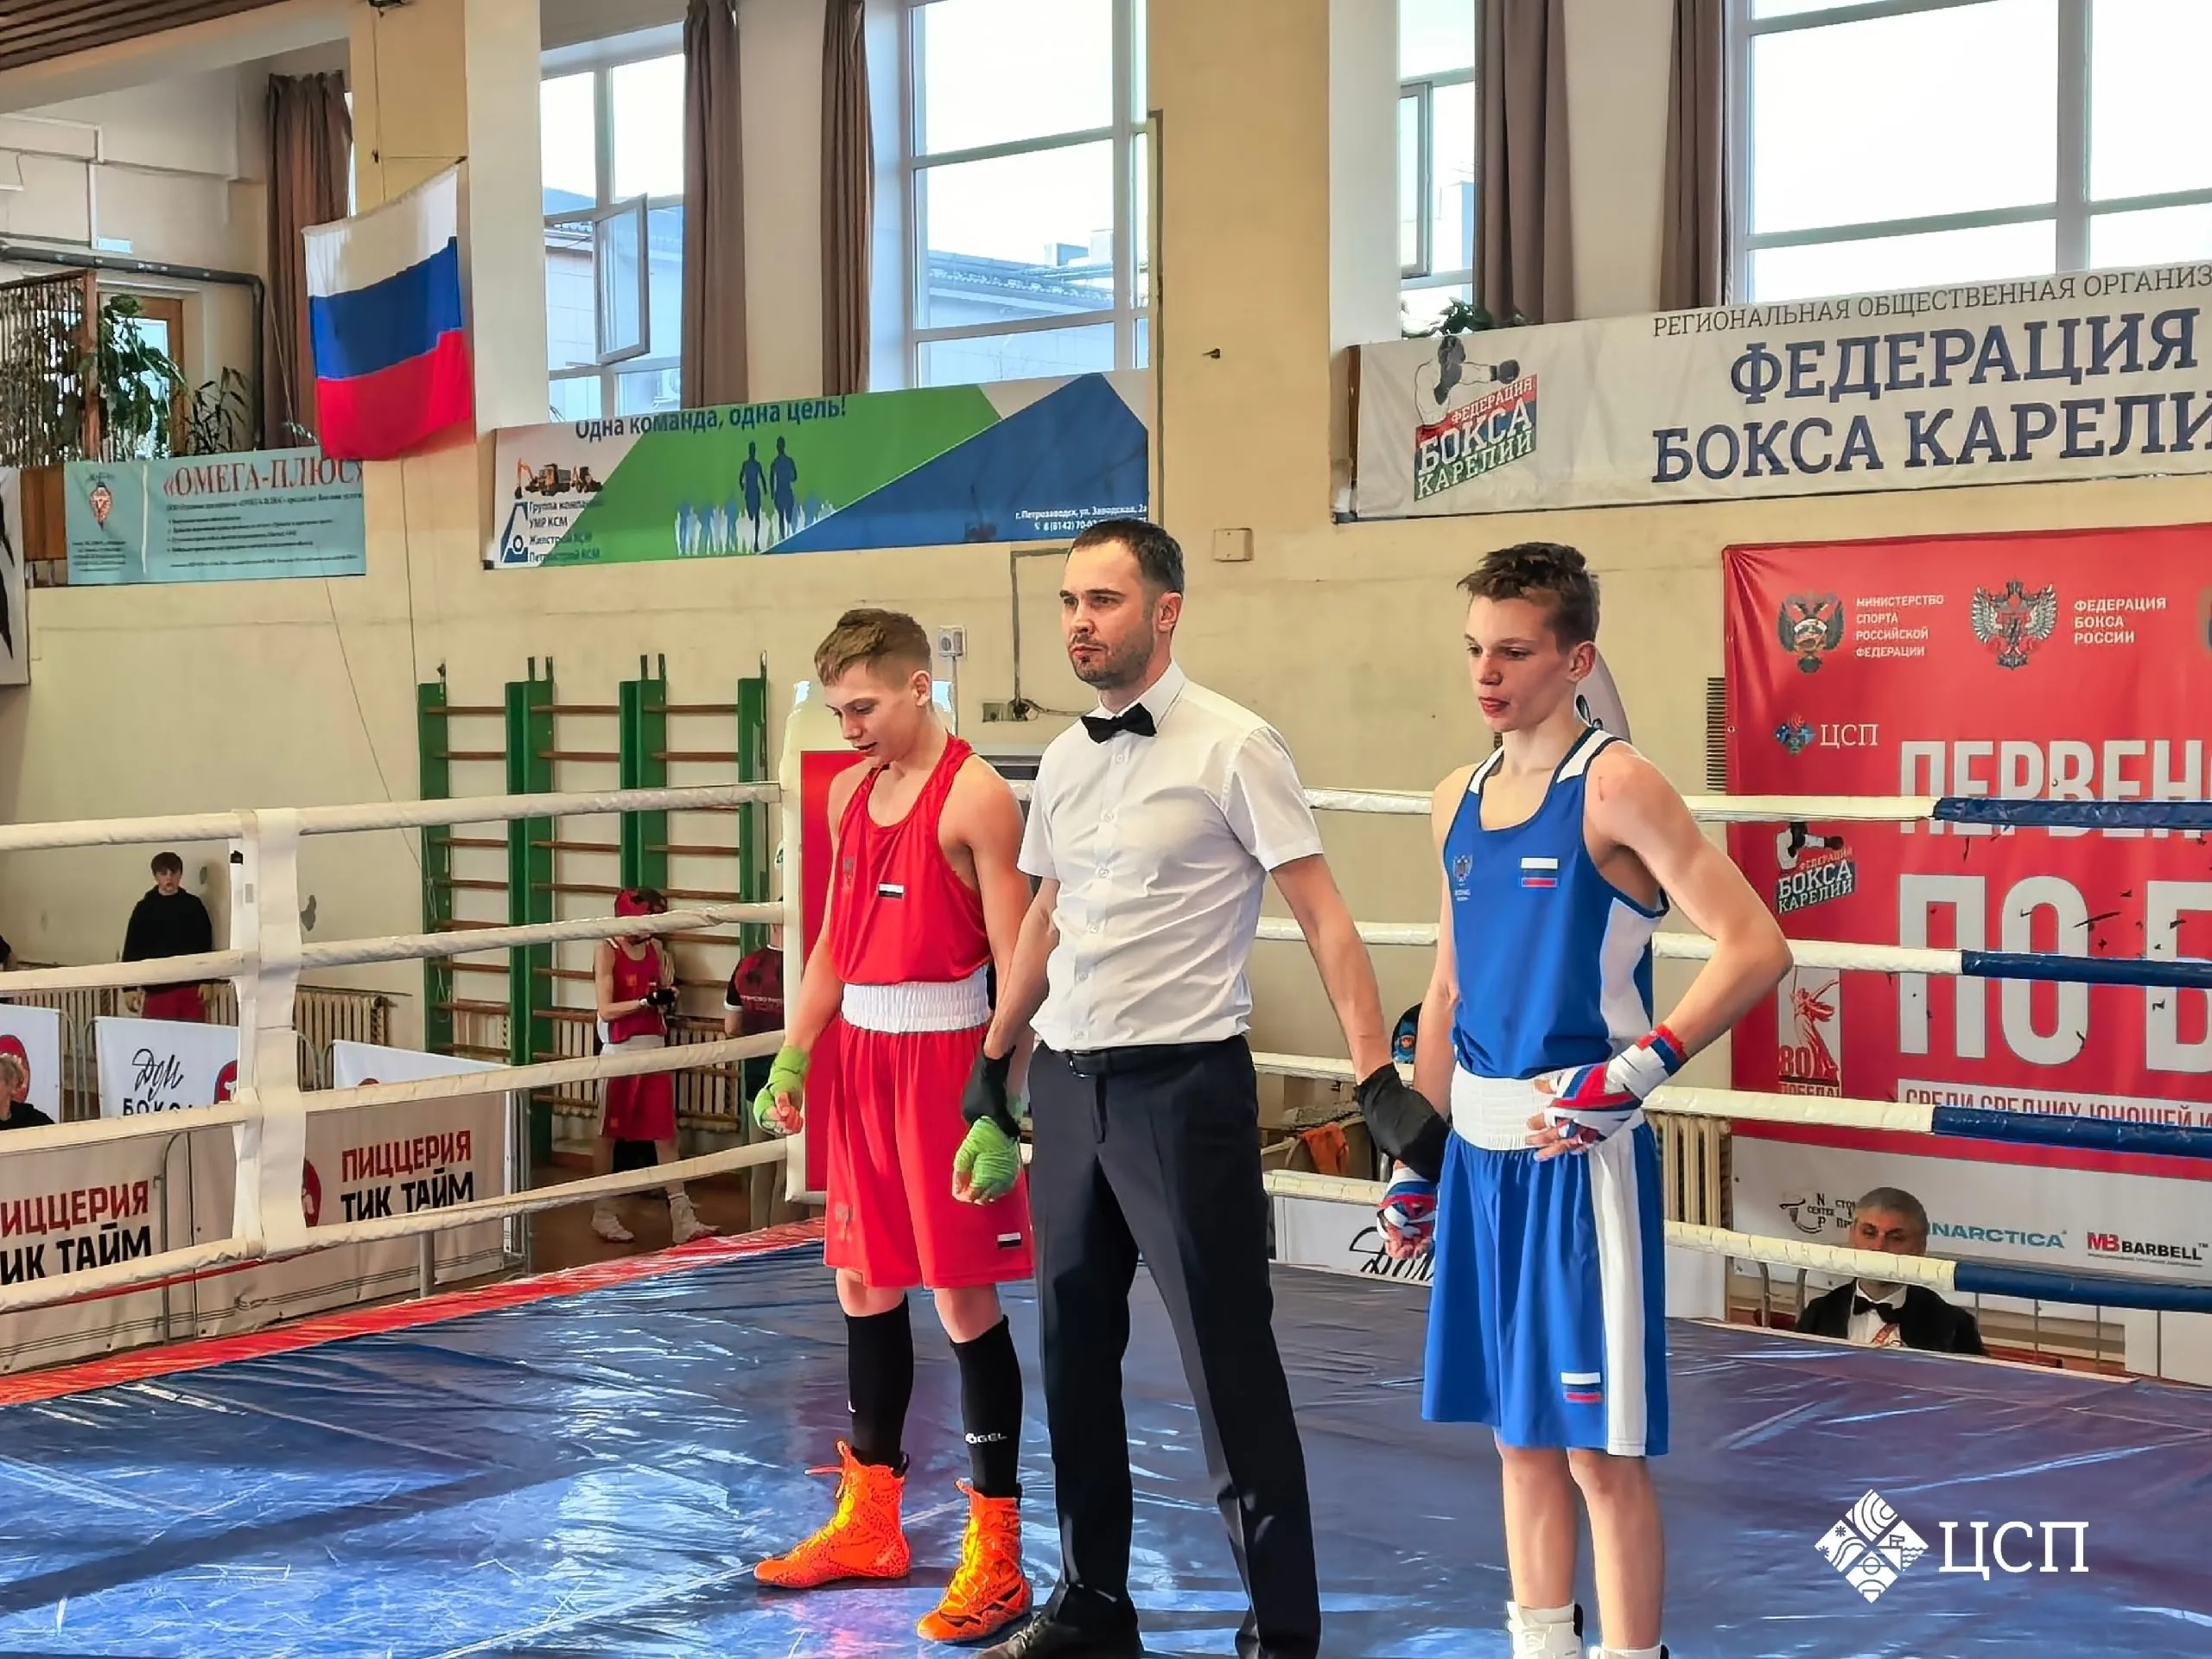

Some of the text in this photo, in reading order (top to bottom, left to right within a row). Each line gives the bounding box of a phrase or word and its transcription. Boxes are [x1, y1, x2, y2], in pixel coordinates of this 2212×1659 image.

[1653, 264, 2212, 337] РЕГИОНАЛЬНАЯ ОБЩЕСТВЕННАЯ ОРГАНИЗ
[1731, 308, 2200, 404] ФЕДЕРАЦИЯ
[575, 396, 846, 442] Одна команда, одна цель!
[1452, 378, 1532, 423] ФЕДЕРАЦИЯ
[1418, 397, 1532, 475] БОКСА
[1651, 391, 2212, 482] БОКСА КАРЕЛИ
[1418, 430, 1532, 499] КАРЕЛИИ
[1856, 594, 1944, 607] МИНИСТЕРСТВО
[1856, 613, 1898, 624] СПОРТА
[2074, 597, 2166, 613] ФЕДЕРАЦИЯ
[1856, 626, 1929, 640] РОССИЙСКОЙ
[2075, 615, 2124, 629] БОКСА
[2075, 631, 2135, 645] РОССИИ
[1856, 646, 1925, 658] ФЕДЕРАЦИИ
[1820, 723, 1878, 749] ЦСП
[1901, 741, 2212, 838] ПЕРВЕН
[1778, 859, 1853, 899] БОКСА
[1778, 879, 1853, 913] КАРЕЛИИ
[1899, 874, 2088, 1065] ПО
[1778, 1045, 1810, 1077] 80
[342, 1130, 471, 1182] ПИЦЦЕРИЯ
[0, 1179, 149, 1237] ИЦЦЕРИЯ
[340, 1167, 474, 1223] ТИК ТАЙМ
[55, 1222, 151, 1274] ТАЙМ
[1927, 1221, 2064, 1249] NARCTICA
[2122, 1240, 2202, 1261] BARBELL
